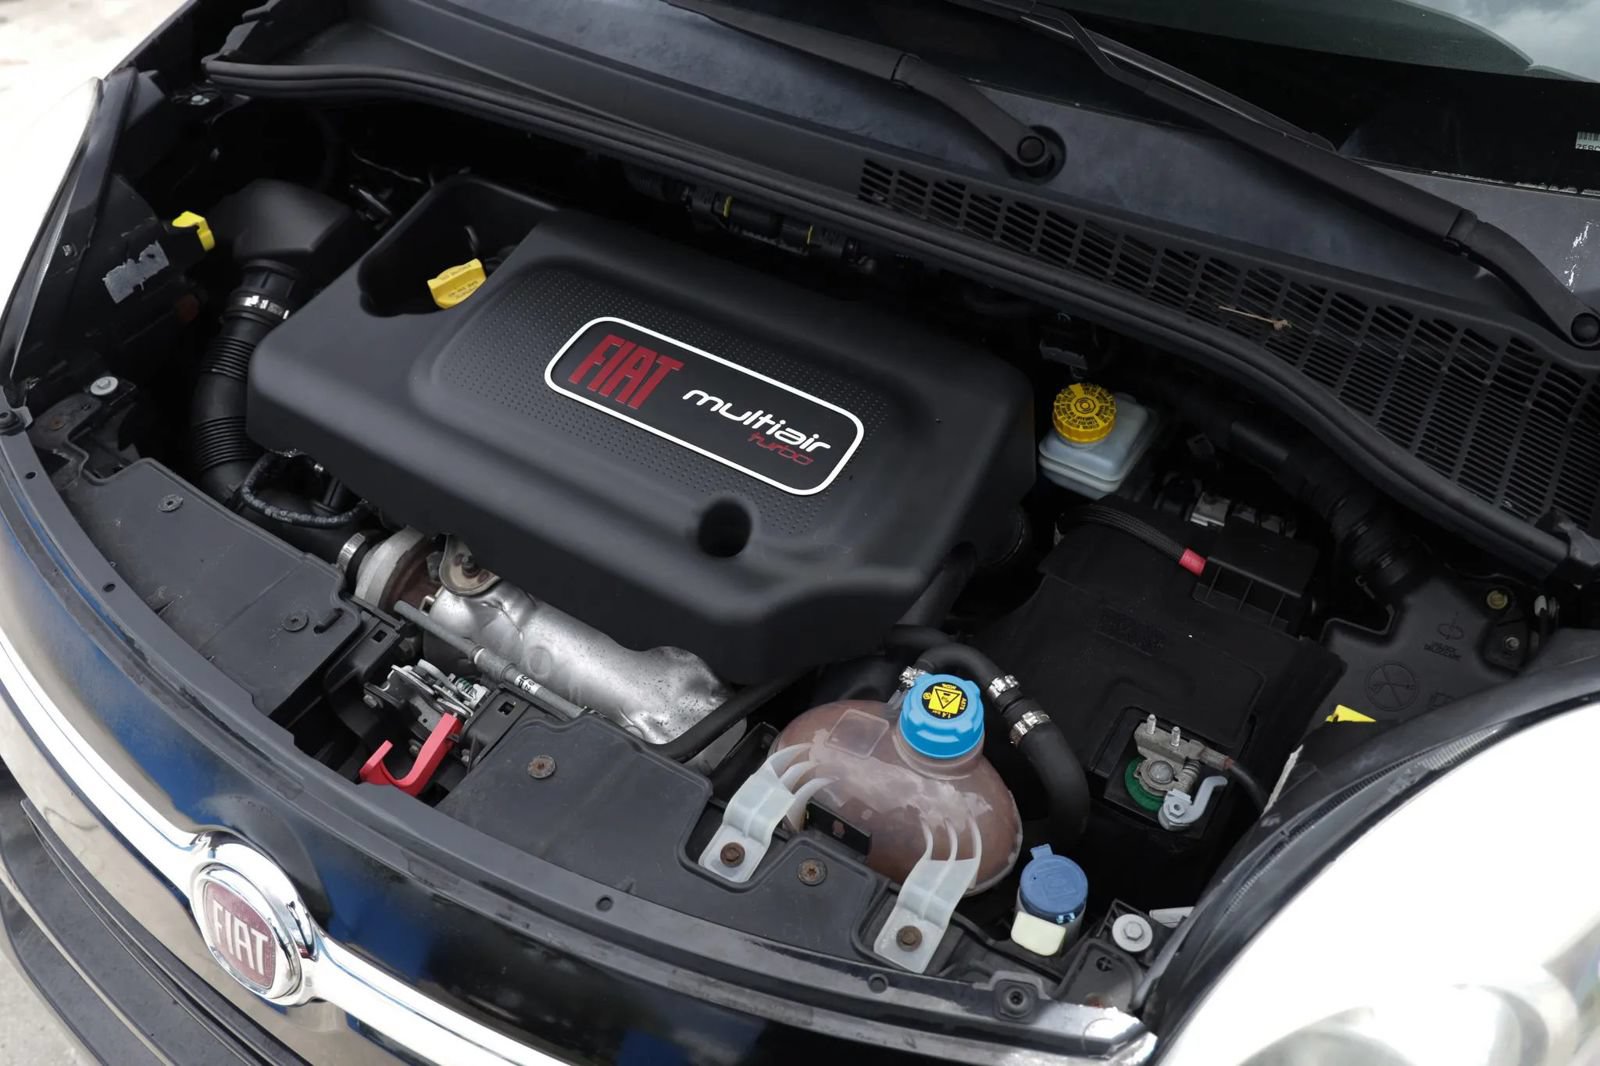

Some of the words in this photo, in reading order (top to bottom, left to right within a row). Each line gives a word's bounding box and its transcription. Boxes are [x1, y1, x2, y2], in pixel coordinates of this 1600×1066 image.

[568, 334, 685, 410] FIAT
[682, 389, 831, 453] multiair
[748, 431, 815, 466] turbo
[213, 900, 268, 976] FIAT
